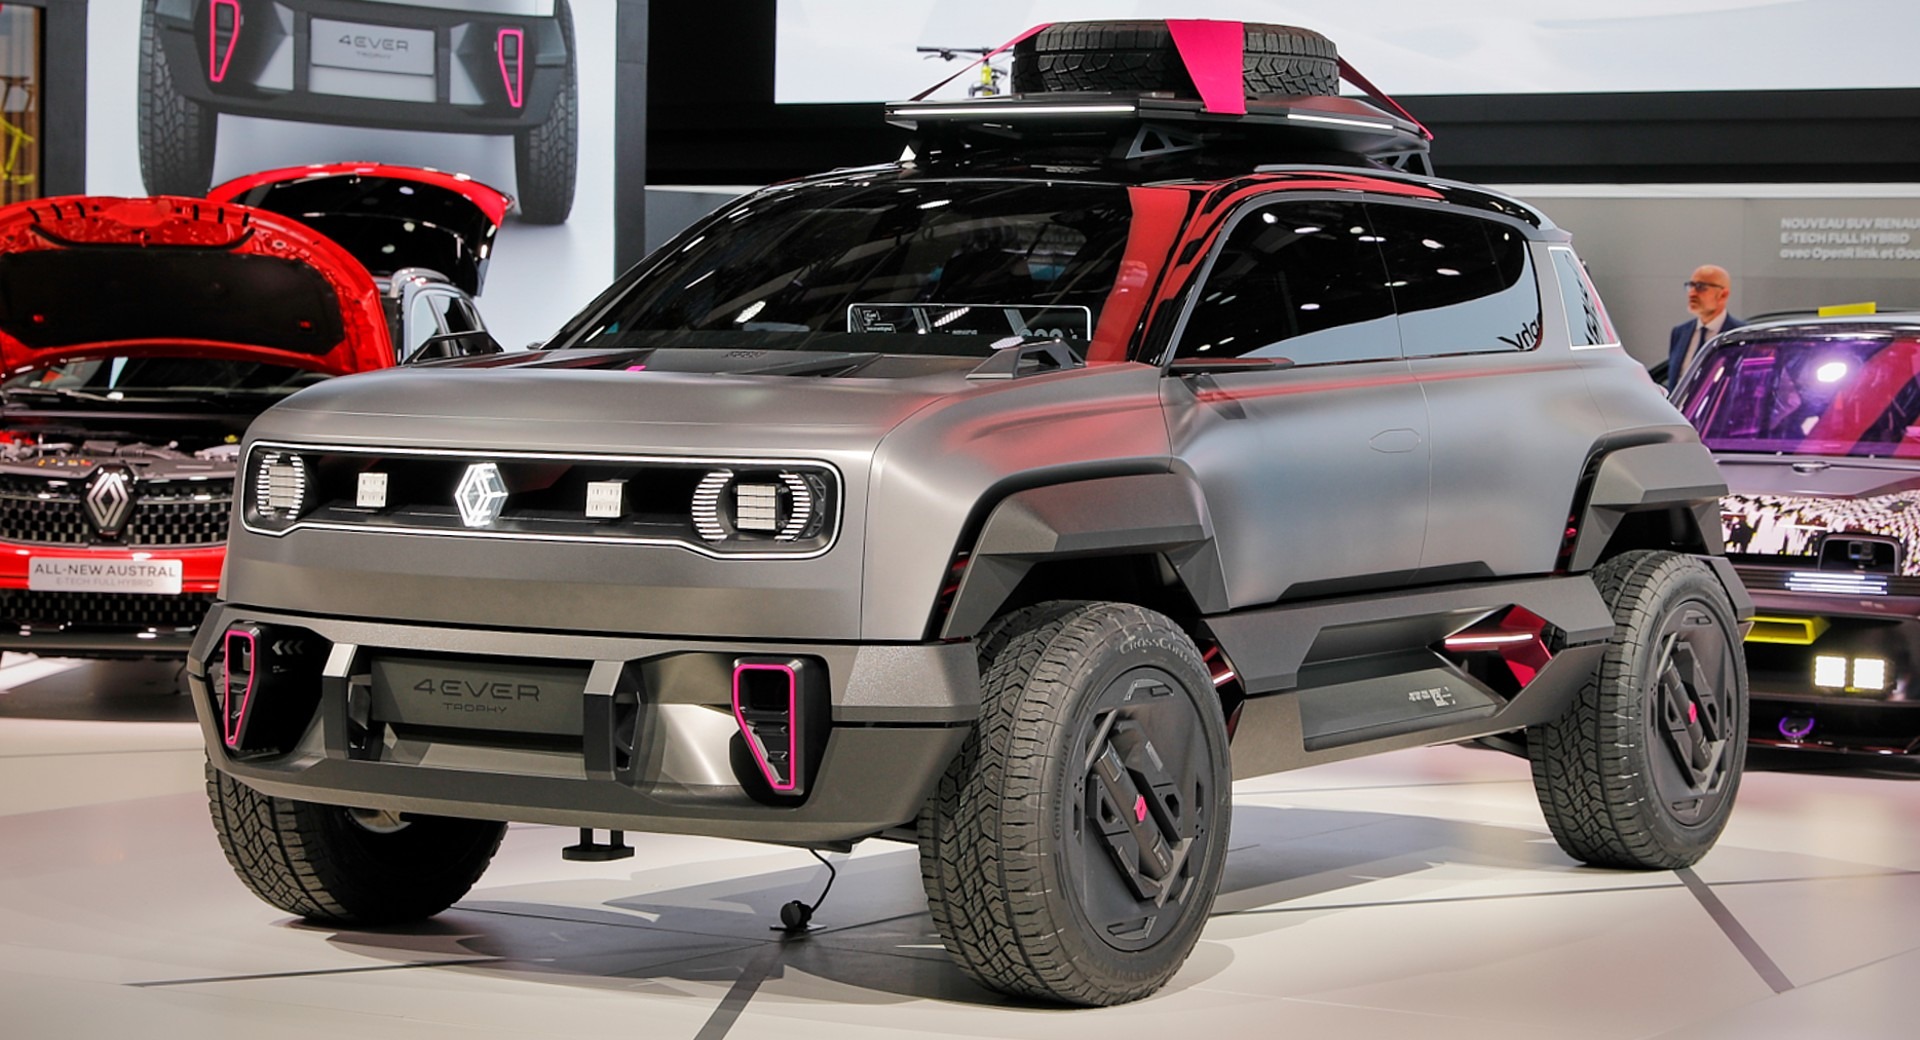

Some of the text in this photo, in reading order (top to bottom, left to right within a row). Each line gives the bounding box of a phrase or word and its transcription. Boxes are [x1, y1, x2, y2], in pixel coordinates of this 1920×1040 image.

[338, 34, 409, 52] 4EVER
[1780, 217, 1845, 230] NOUVEAU
[1846, 217, 1873, 230] SUV
[1780, 231, 1910, 245] E-TECH FULL HYBRID
[1779, 248, 1811, 259] avec
[34, 563, 176, 578] ALL-NEW AUSTRAL
[56, 576, 154, 588] E-TECH FULL HYBRID
[413, 678, 540, 702] 4EVER
[443, 702, 508, 714] TROPHY
